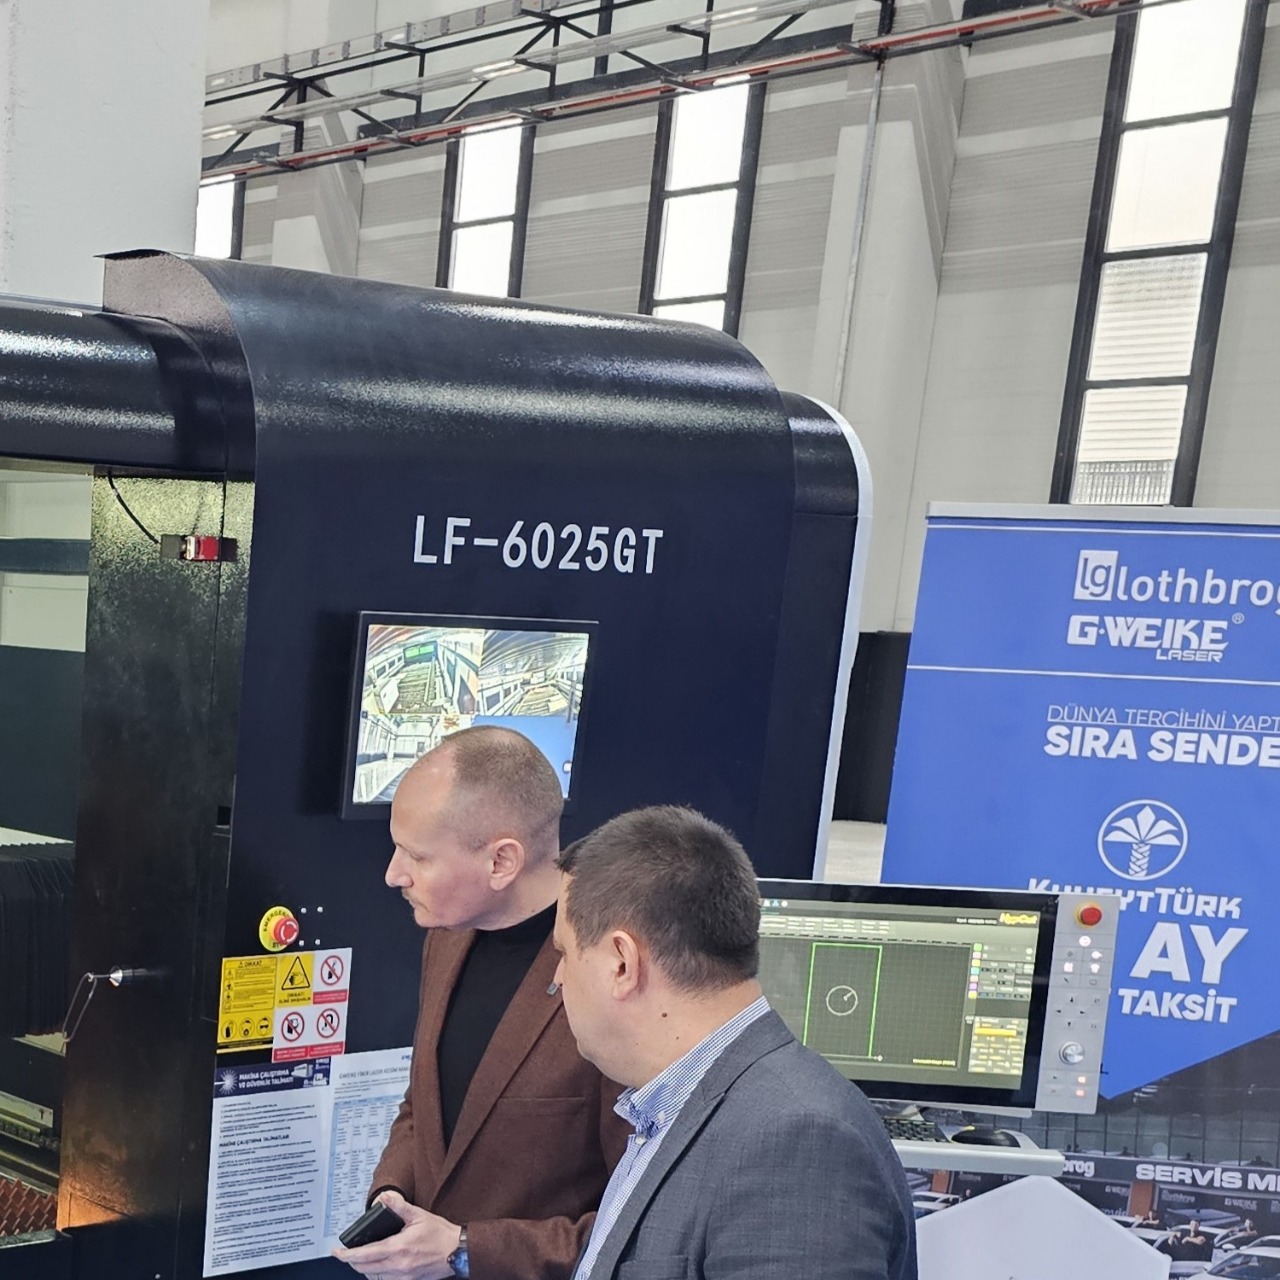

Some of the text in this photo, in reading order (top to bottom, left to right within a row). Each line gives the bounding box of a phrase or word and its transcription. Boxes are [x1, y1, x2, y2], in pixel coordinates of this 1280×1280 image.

[413, 515, 664, 573] LF-6025GT
[1155, 649, 1223, 662] LASER
[1047, 703, 1118, 724] DÜNYA
[1124, 708, 1227, 730] TERCİHİNİ
[1043, 725, 1280, 768] SIRA SENDE
[1129, 921, 1250, 985] AY
[1118, 988, 1238, 1023] TAKSİT
[1136, 1163, 1242, 1189] SERVİS
